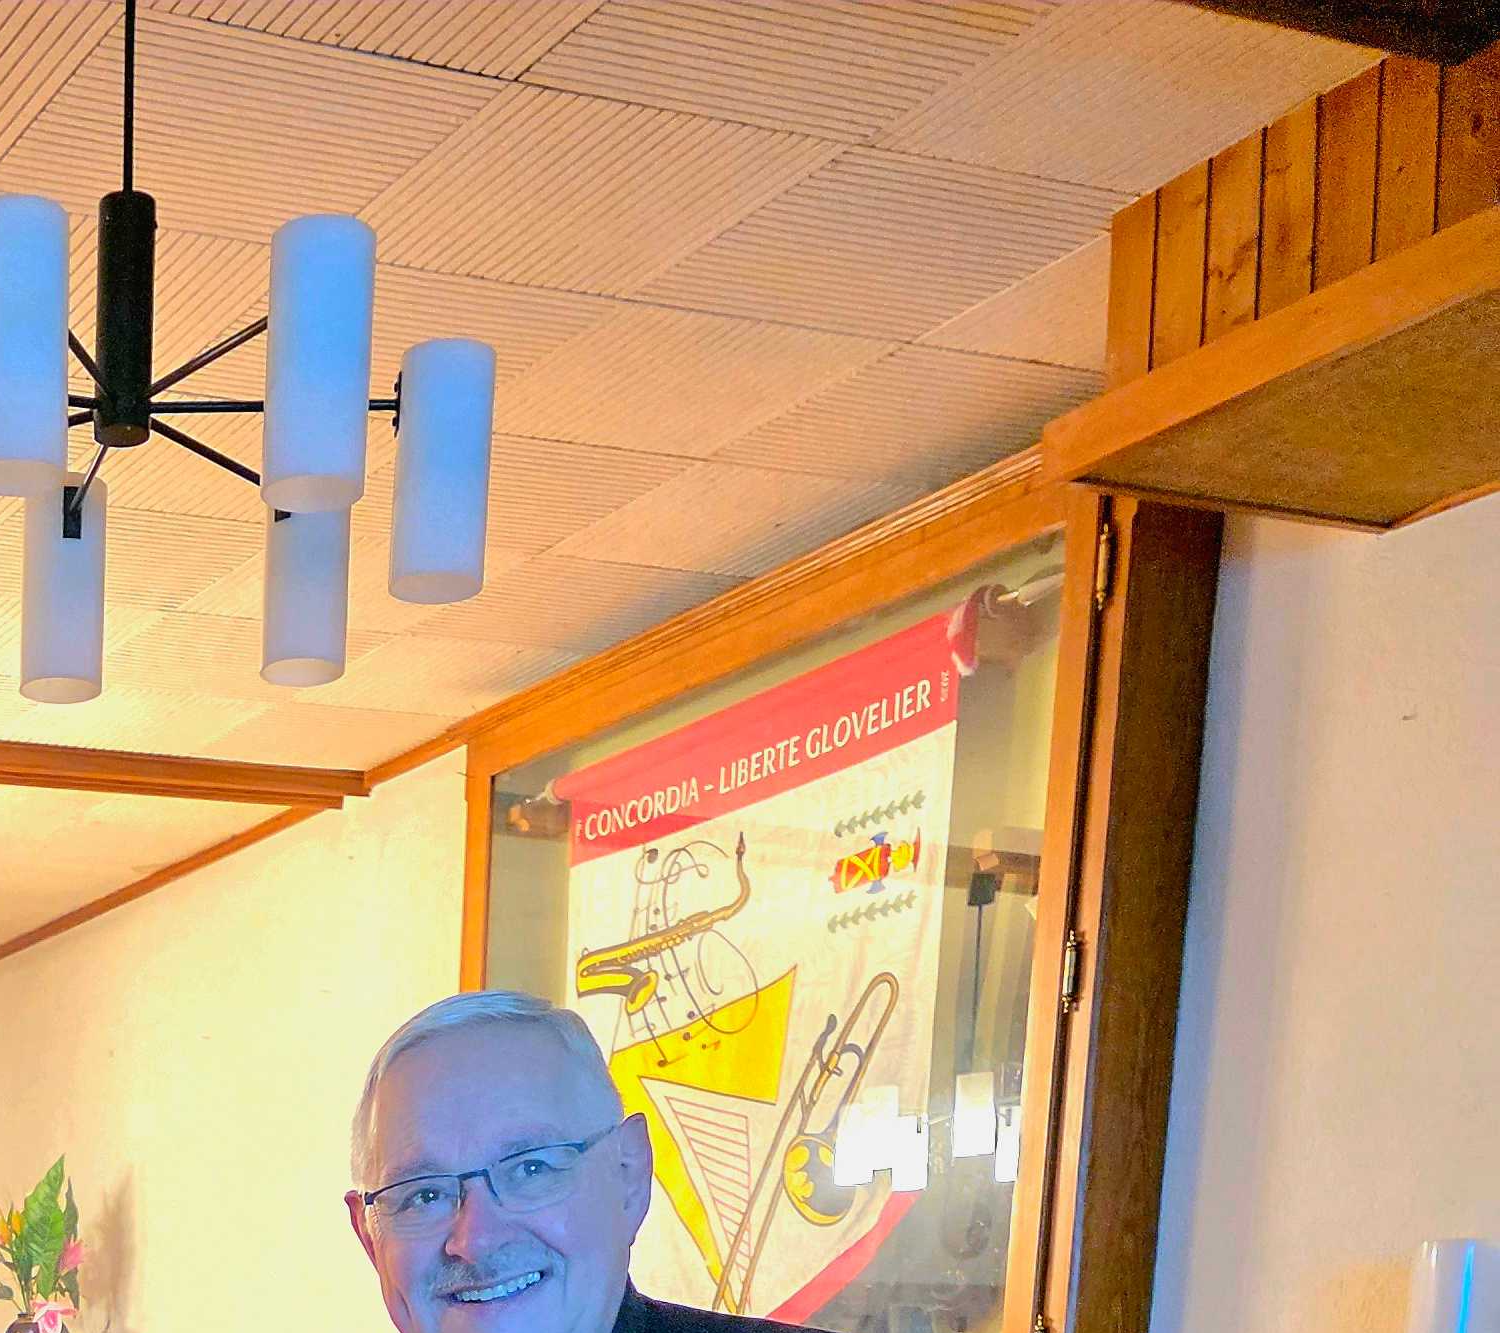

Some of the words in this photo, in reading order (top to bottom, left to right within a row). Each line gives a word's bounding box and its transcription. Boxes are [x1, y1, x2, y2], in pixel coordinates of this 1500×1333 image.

[584, 776, 700, 841] CONCORDIA
[719, 735, 801, 795] LIBERTE
[805, 679, 932, 760] GLOVELIER
